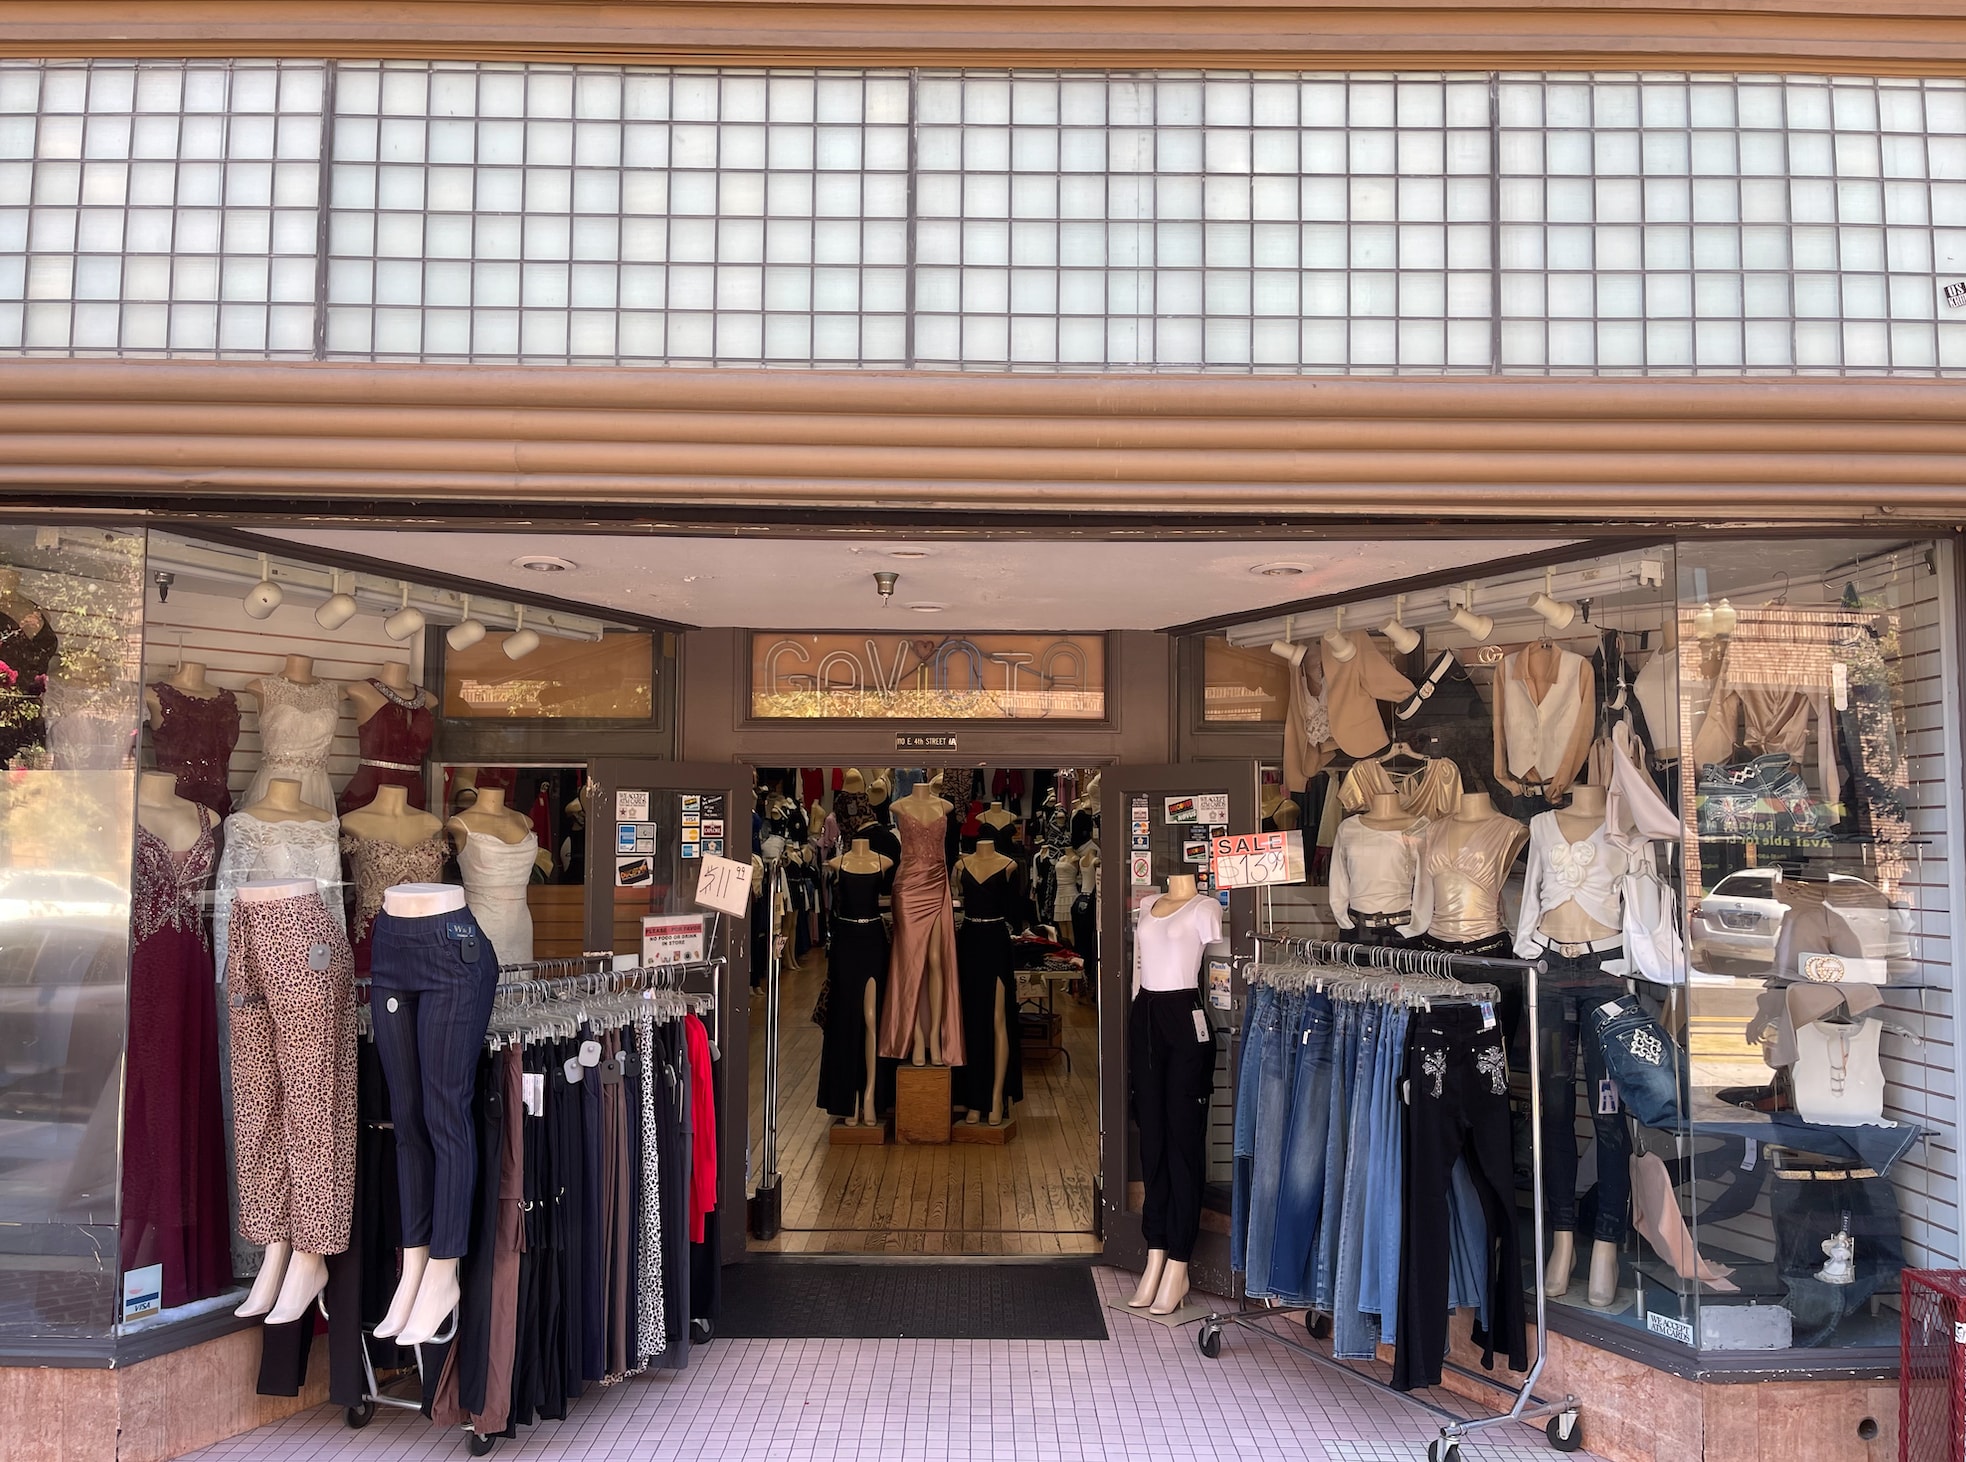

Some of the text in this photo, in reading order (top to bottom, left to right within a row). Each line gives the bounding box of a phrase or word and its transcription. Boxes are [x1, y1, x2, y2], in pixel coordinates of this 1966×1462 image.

[1218, 834, 1282, 854] SALE
[134, 1302, 151, 1312] VISA
[1650, 1314, 1690, 1335] WE ACCEPT
[1650, 1323, 1690, 1342] ATM CARDS
